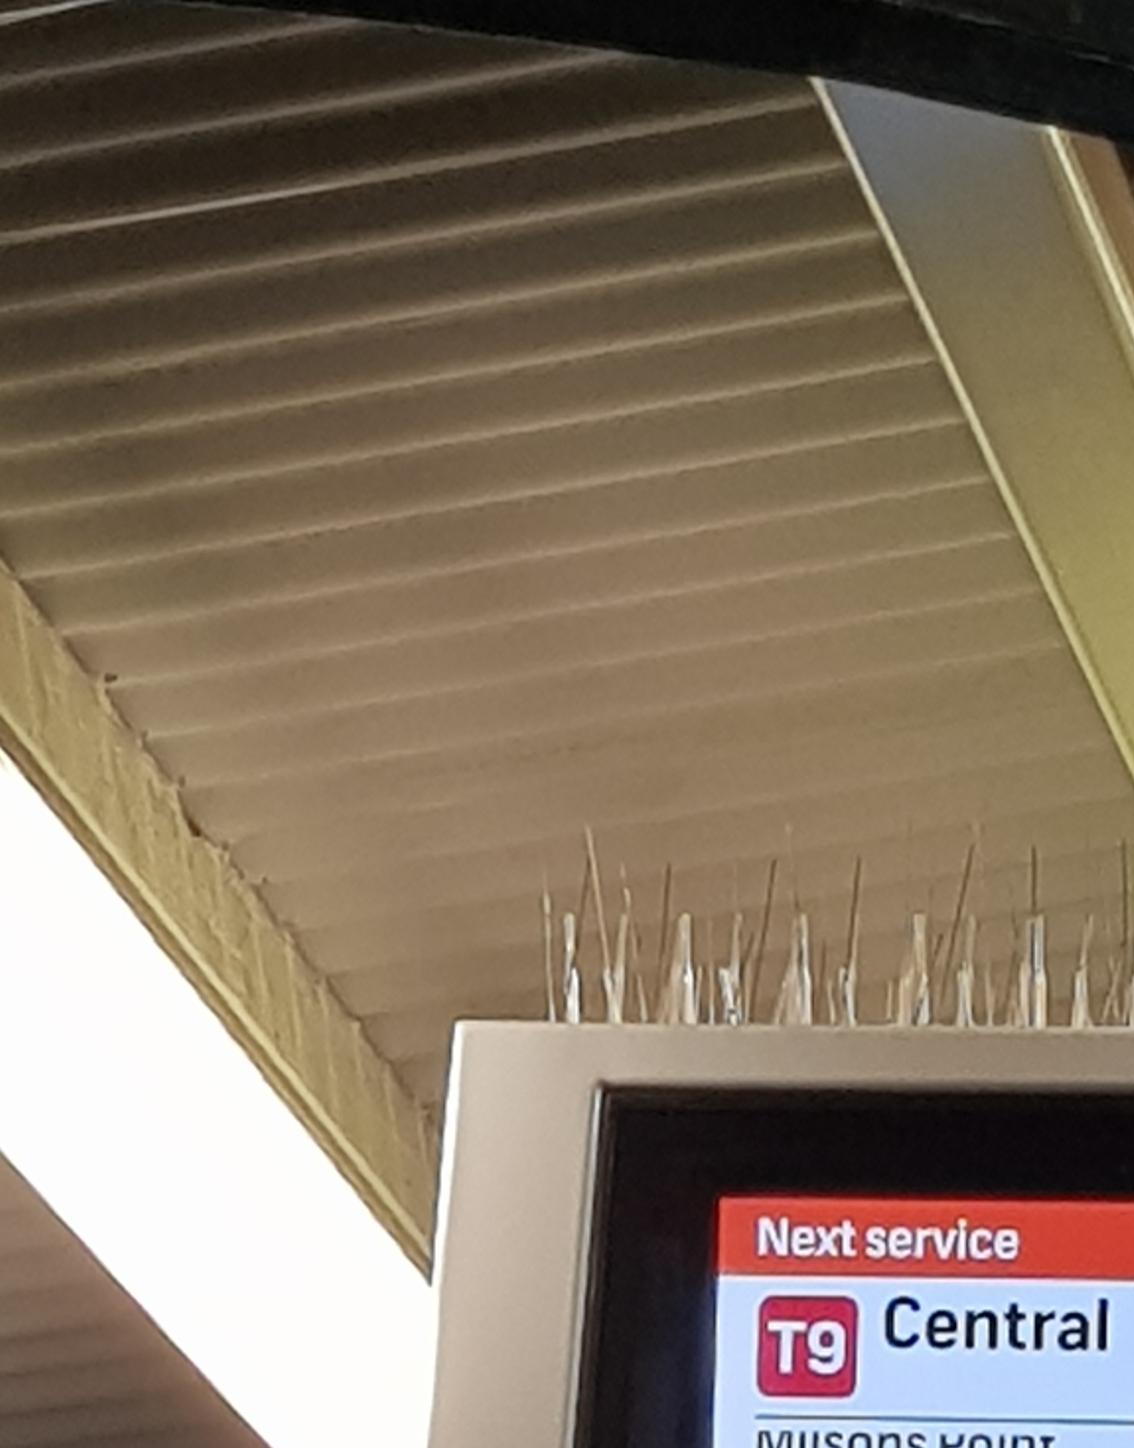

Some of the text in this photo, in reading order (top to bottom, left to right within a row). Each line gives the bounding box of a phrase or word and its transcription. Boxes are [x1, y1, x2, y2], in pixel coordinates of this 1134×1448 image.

[758, 1217, 1019, 1260] Next service
[767, 1320, 846, 1375] T9
[885, 1296, 1109, 1351] Central
